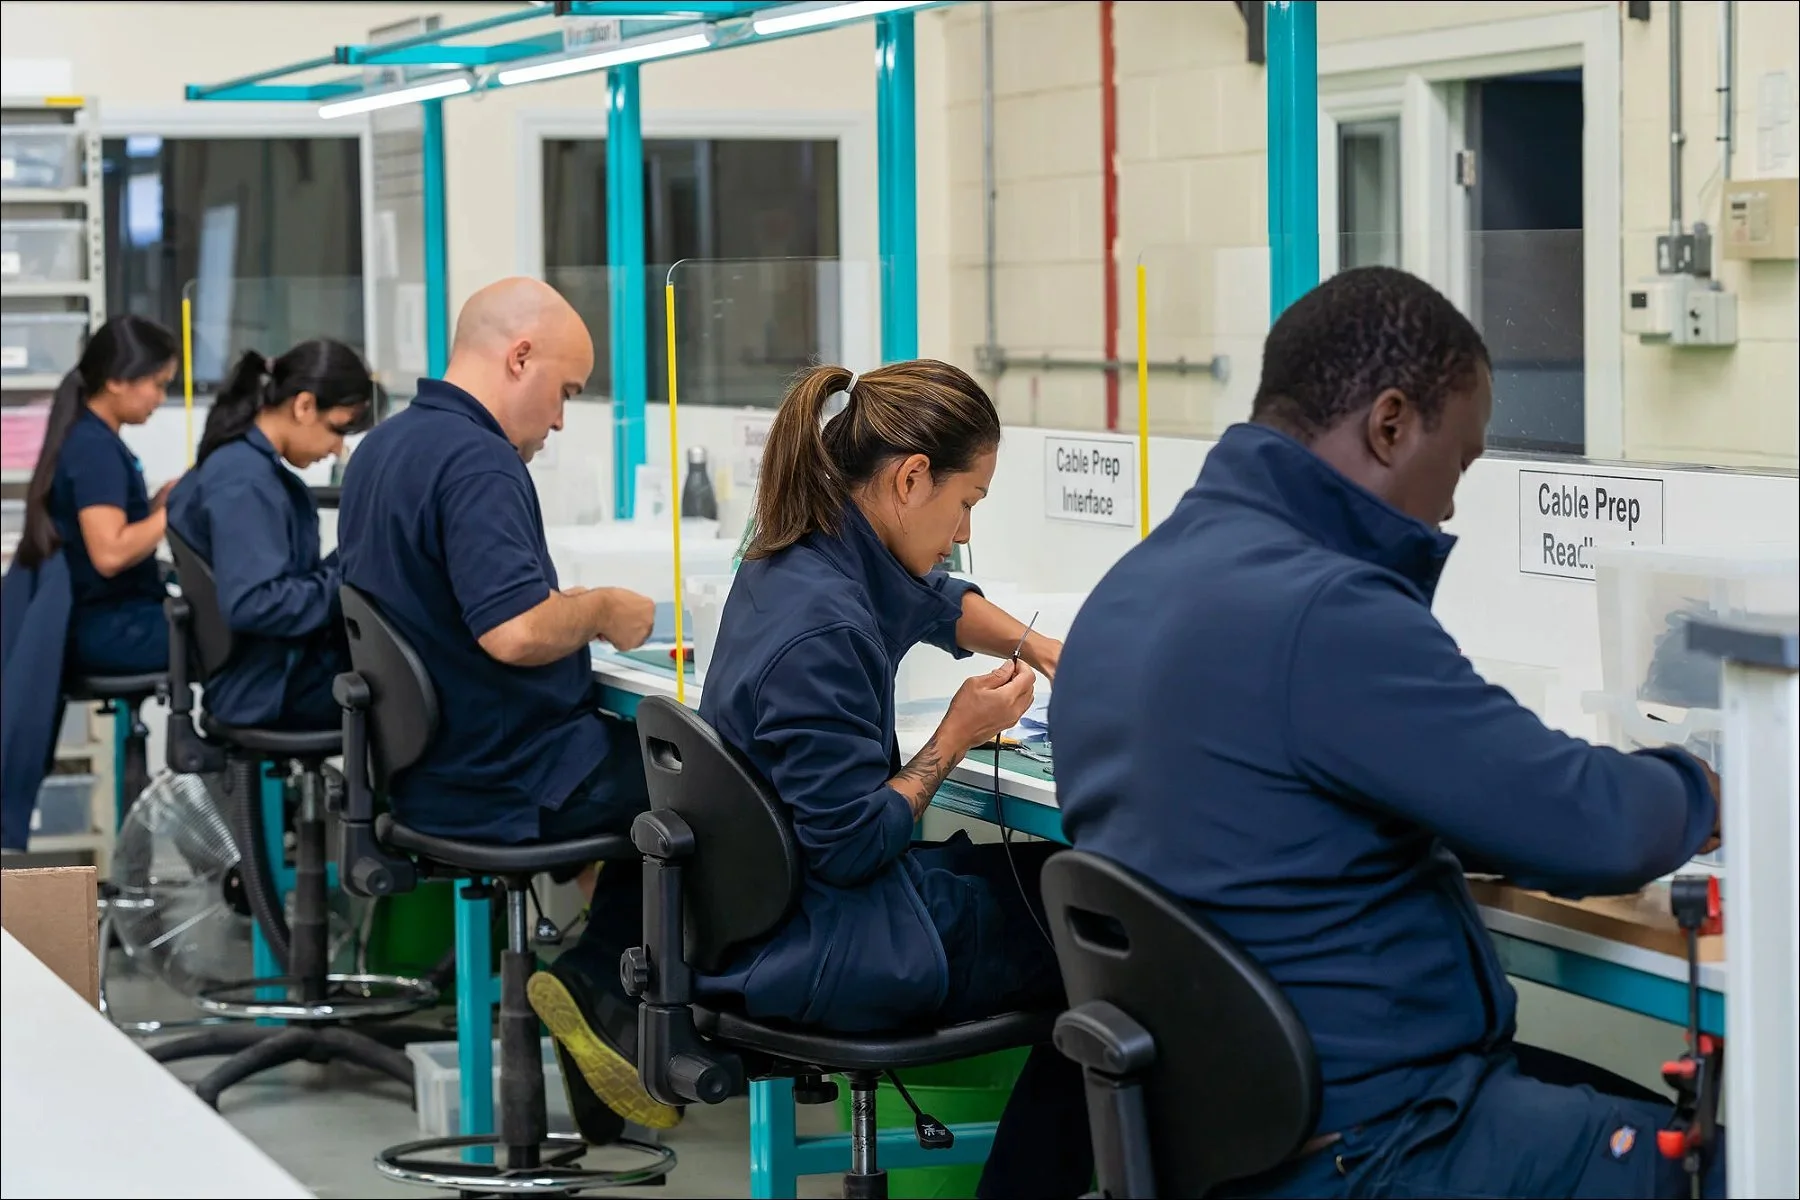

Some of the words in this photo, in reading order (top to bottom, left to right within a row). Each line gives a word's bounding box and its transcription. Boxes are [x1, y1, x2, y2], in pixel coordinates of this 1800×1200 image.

[1056, 447, 1089, 474] Cable
[1092, 450, 1120, 483] Prep
[1062, 486, 1113, 516] Interface
[1538, 482, 1589, 519] Cable
[1595, 487, 1640, 531] Prep
